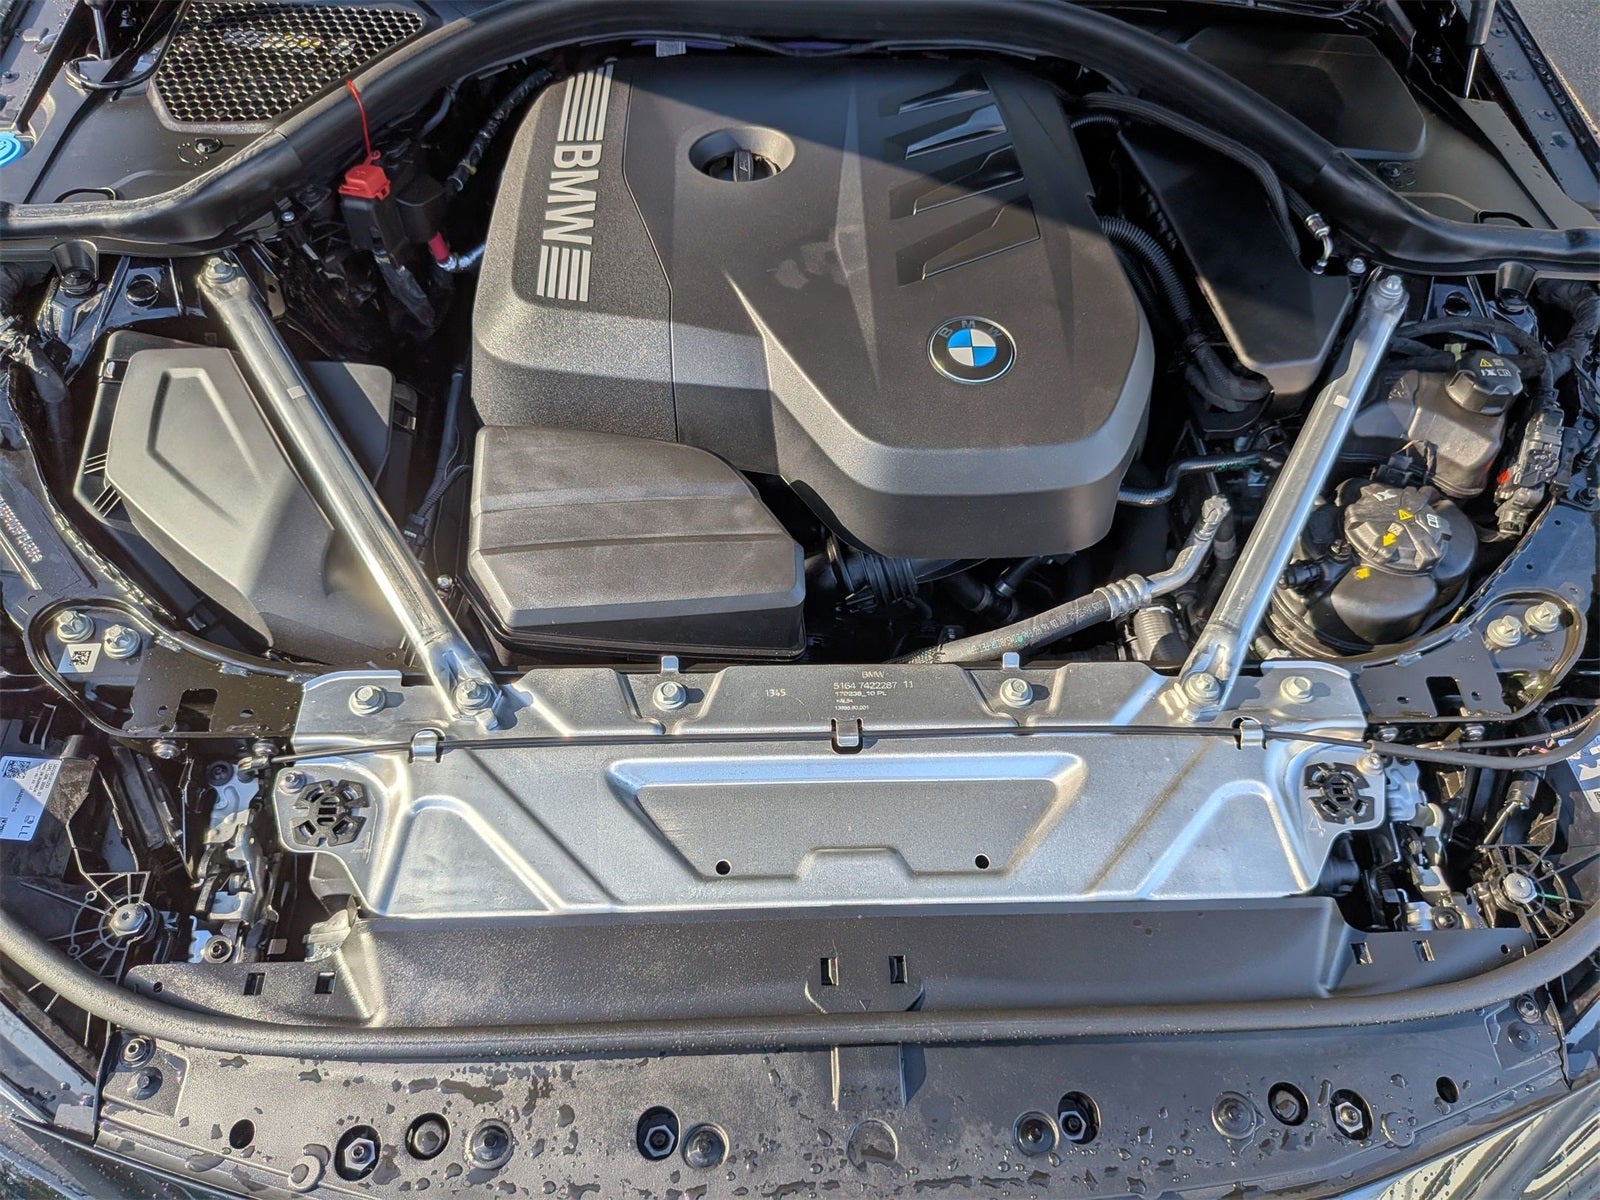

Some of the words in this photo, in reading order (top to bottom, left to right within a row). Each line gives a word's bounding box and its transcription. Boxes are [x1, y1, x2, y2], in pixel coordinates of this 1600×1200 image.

[542, 144, 602, 245] BMW
[938, 319, 1003, 339] BMW
[861, 670, 885, 679] BMW
[833, 681, 856, 690] 5164
[858, 681, 898, 690] 7422287
[903, 680, 914, 689] 11
